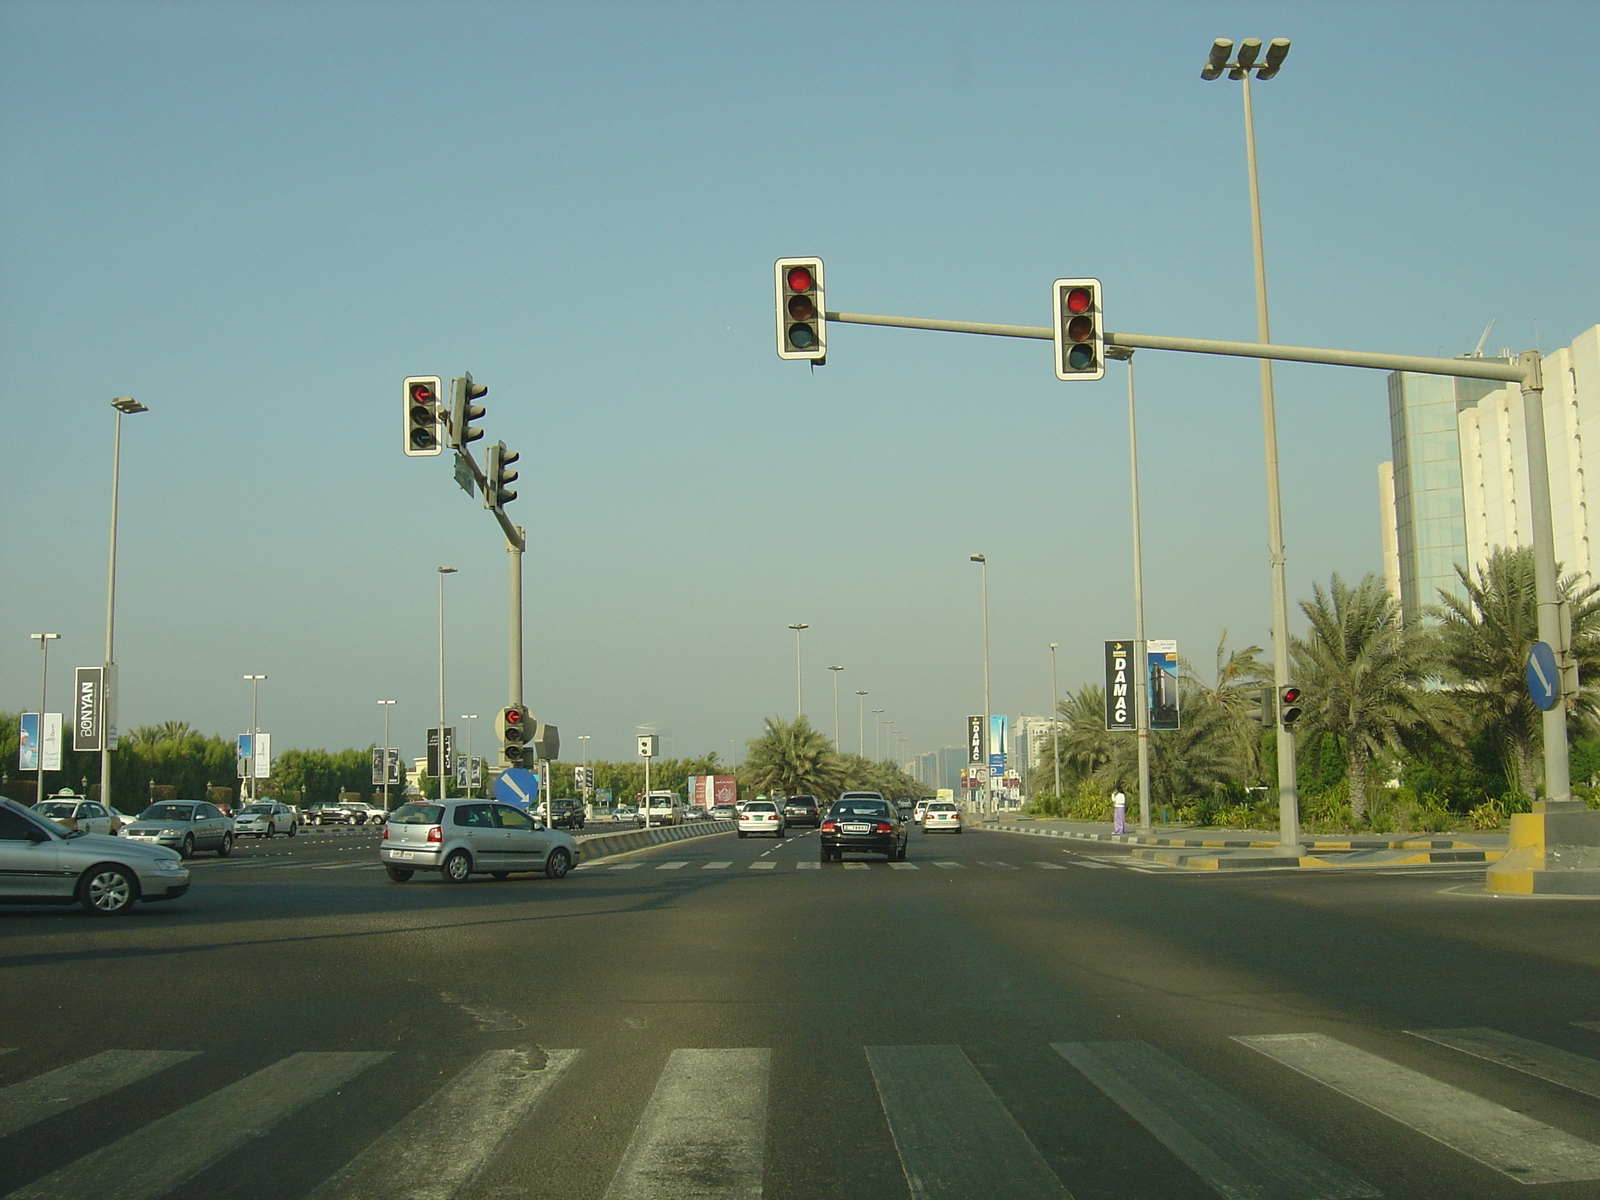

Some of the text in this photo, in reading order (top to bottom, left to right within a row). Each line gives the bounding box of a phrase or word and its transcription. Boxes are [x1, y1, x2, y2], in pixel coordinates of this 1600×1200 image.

[81, 682, 93, 737] BONYAN
[1113, 658, 1127, 723] DAMAC
[991, 767, 997, 776] P
